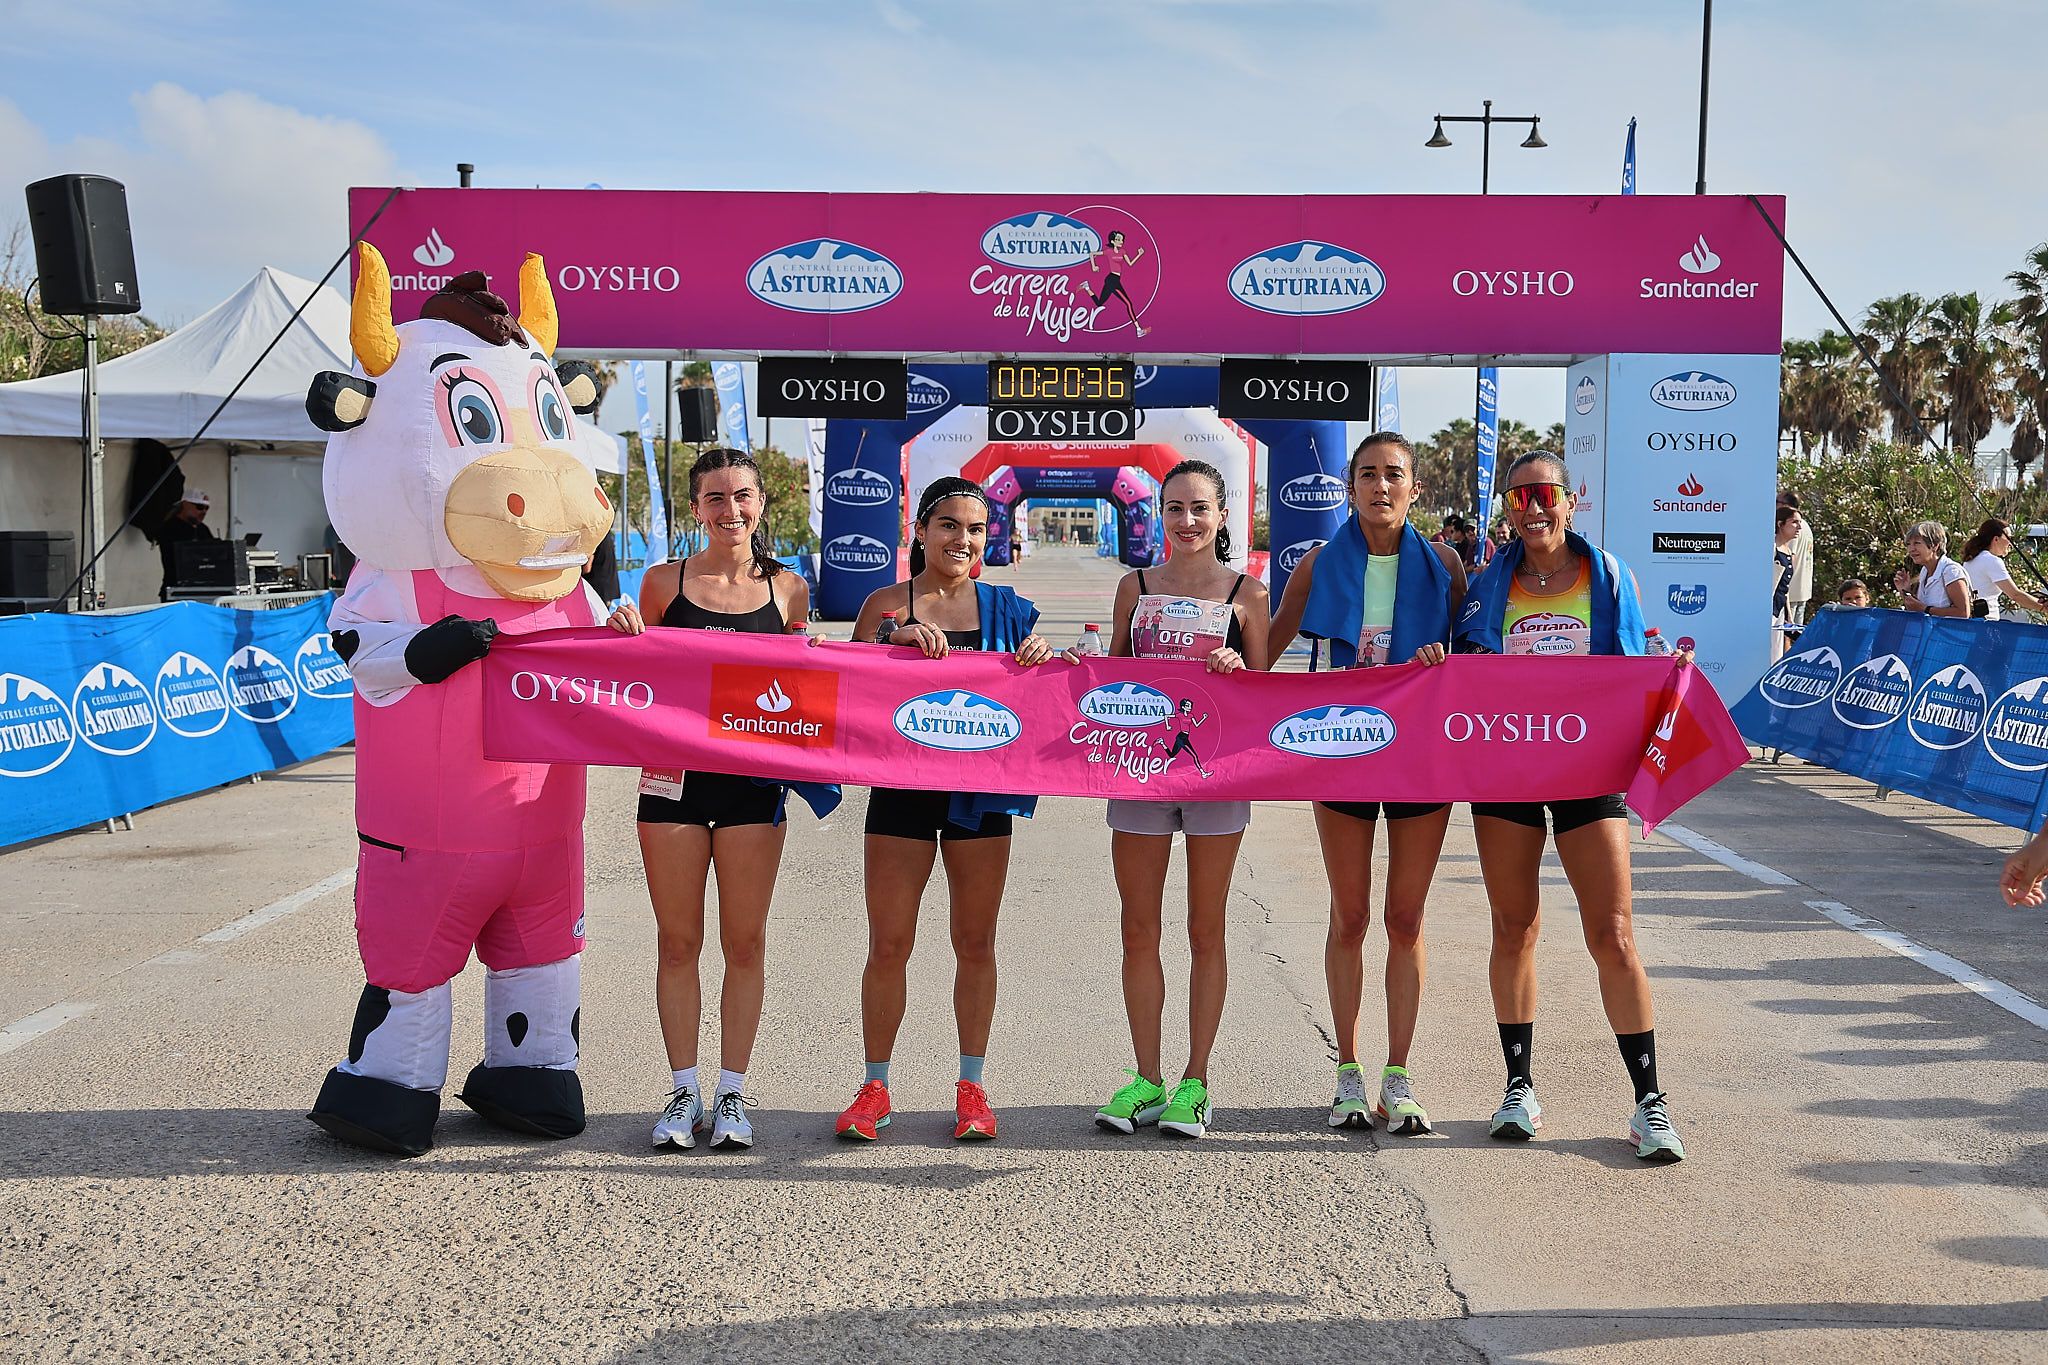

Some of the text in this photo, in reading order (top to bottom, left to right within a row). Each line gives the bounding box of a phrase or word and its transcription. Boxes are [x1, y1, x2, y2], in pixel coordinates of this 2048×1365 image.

[990, 232, 1091, 254] ASTURIANA
[558, 265, 680, 293] OYSHO
[759, 265, 891, 294] ASTURIANA
[783, 264, 886, 273] CENTRAL LECHERA
[969, 264, 1069, 296] Carrera
[1240, 268, 1373, 296] ASTURIANA
[1452, 270, 1574, 296] OYSHO
[1640, 277, 1759, 299] Santander
[993, 293, 1106, 343] de la Mujer
[781, 378, 886, 402] OYSHO
[998, 367, 1124, 398] 00:20:36
[1243, 377, 1350, 403] OYSHO
[1656, 385, 1730, 401] ASTURIANA
[907, 392, 943, 405] RIANA
[995, 409, 1129, 437] OYSHO
[932, 433, 972, 442] OYSHO
[1184, 433, 1224, 443] OYSHO
[1647, 432, 1737, 452] OYSHO
[829, 481, 889, 498] ASTURIANA
[1285, 487, 1343, 501] ASTURIANA
[1653, 499, 1727, 512] Santander
[827, 546, 886, 564] ASTURIANA
[1657, 536, 1721, 552] Neutrogena
[1670, 591, 1705, 607] Marlene
[1159, 630, 1195, 646] 016
[302, 663, 352, 691] ASTUR
[1696, 661, 1726, 673] nergy
[229, 677, 294, 707] ASTURIANA
[511, 671, 654, 710] OYSHO
[1764, 664, 1831, 697] ASTURIANA
[162, 687, 226, 720] ASTURIANA
[1086, 697, 1166, 717] ASTURIANA
[1835, 676, 1904, 716] ASTURIANA
[0, 710, 23, 721] NTRAL
[82, 700, 153, 737] ASTURIANA
[902, 708, 1011, 738] ASTURIANA
[923, 708, 1008, 720] CENTRAL LECHERA
[1911, 690, 1978, 733] ASTURIANA
[0, 717, 70, 753] TURIANA
[721, 713, 823, 737] Santander
[1069, 721, 1148, 748] Carrera
[1280, 726, 1387, 745] ASTURIANA
[1299, 720, 1339, 730] CENTRAL
[1443, 712, 1588, 744] OYSHO
[1987, 704, 2048, 750] ASTURIA
[1087, 745, 1177, 784] de la Mujer
